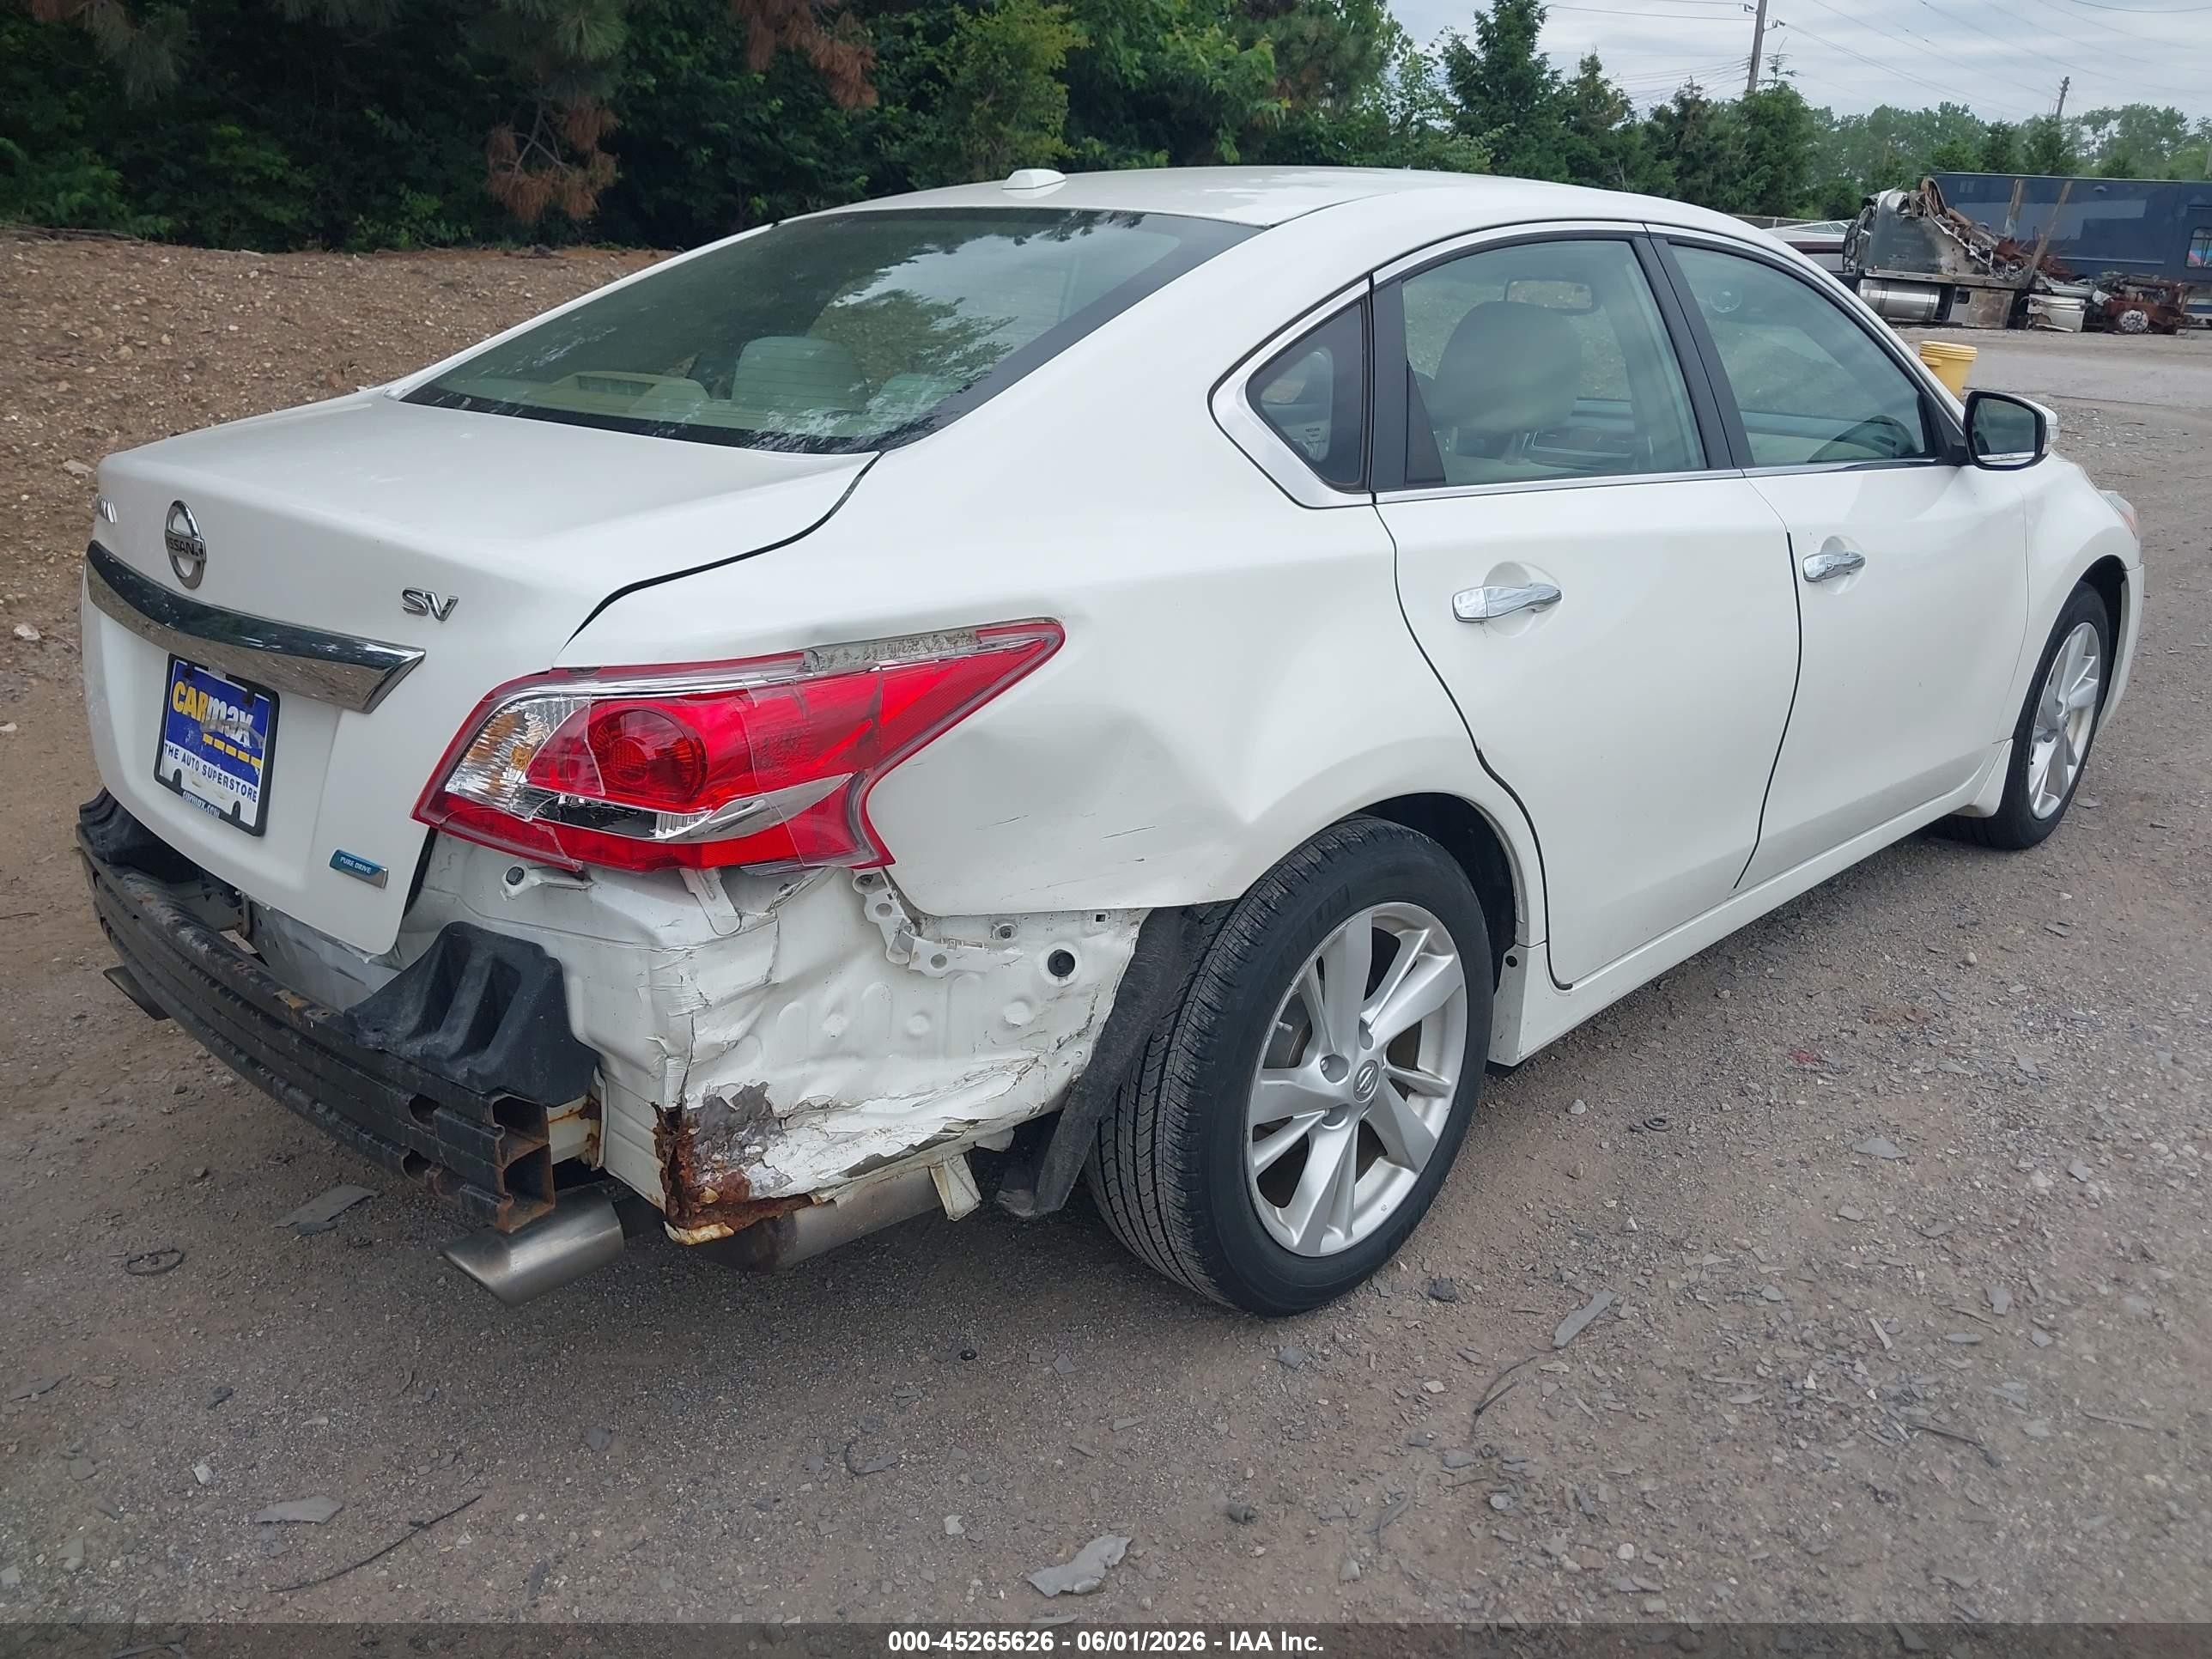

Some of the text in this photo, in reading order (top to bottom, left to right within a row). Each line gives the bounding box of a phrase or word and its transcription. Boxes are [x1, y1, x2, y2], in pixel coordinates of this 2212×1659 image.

[402, 587, 459, 622] SV
[164, 744, 258, 803] THE AUTO SUPERSTORE
[340, 856, 372, 874] PURE DRIVE
